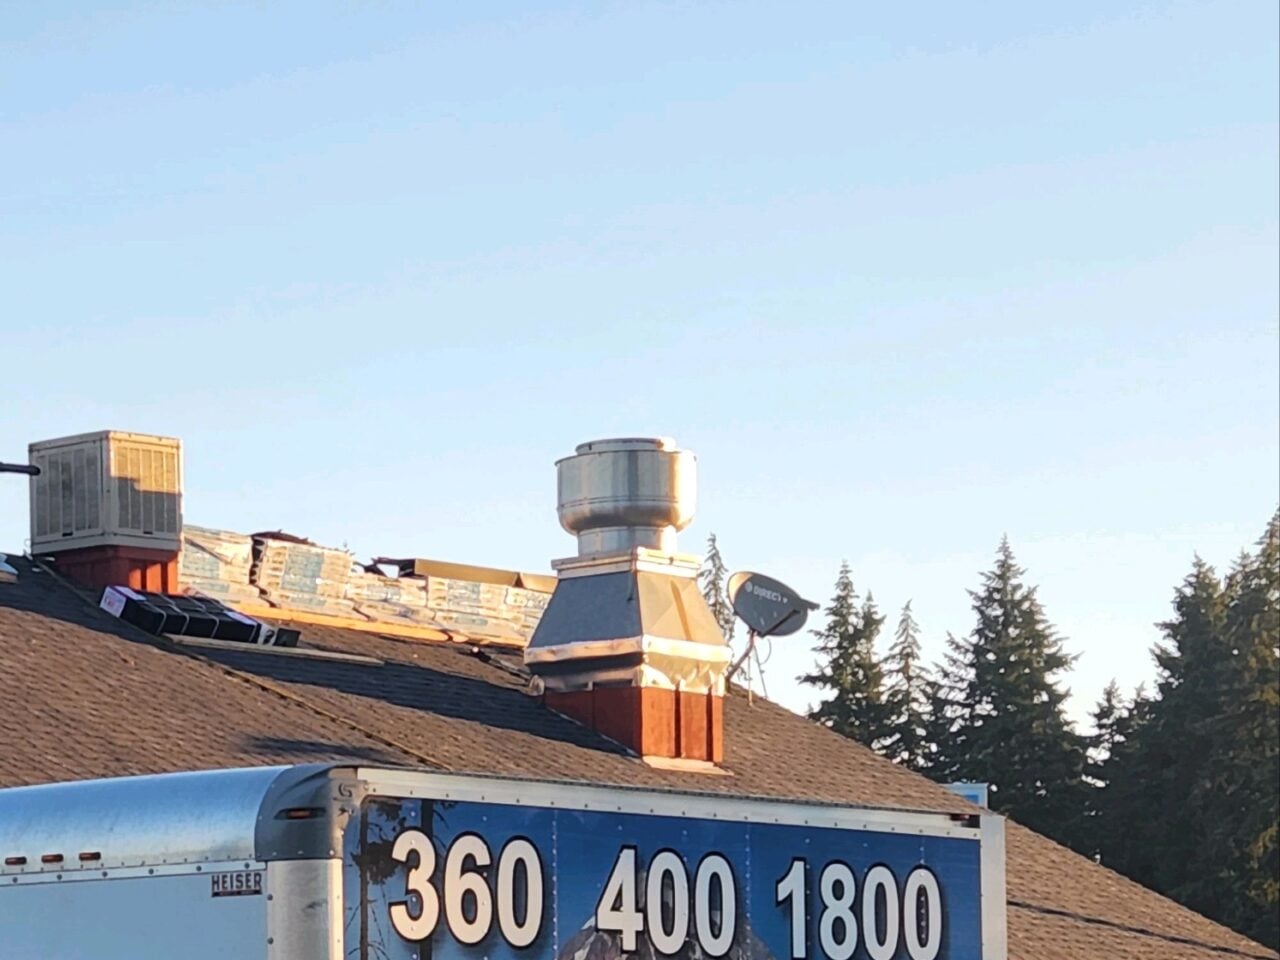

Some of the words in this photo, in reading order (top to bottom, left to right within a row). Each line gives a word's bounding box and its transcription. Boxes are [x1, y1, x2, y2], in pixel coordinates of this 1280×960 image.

[211, 872, 262, 891] HEISER
[389, 829, 543, 948] 360
[596, 846, 735, 957] 400
